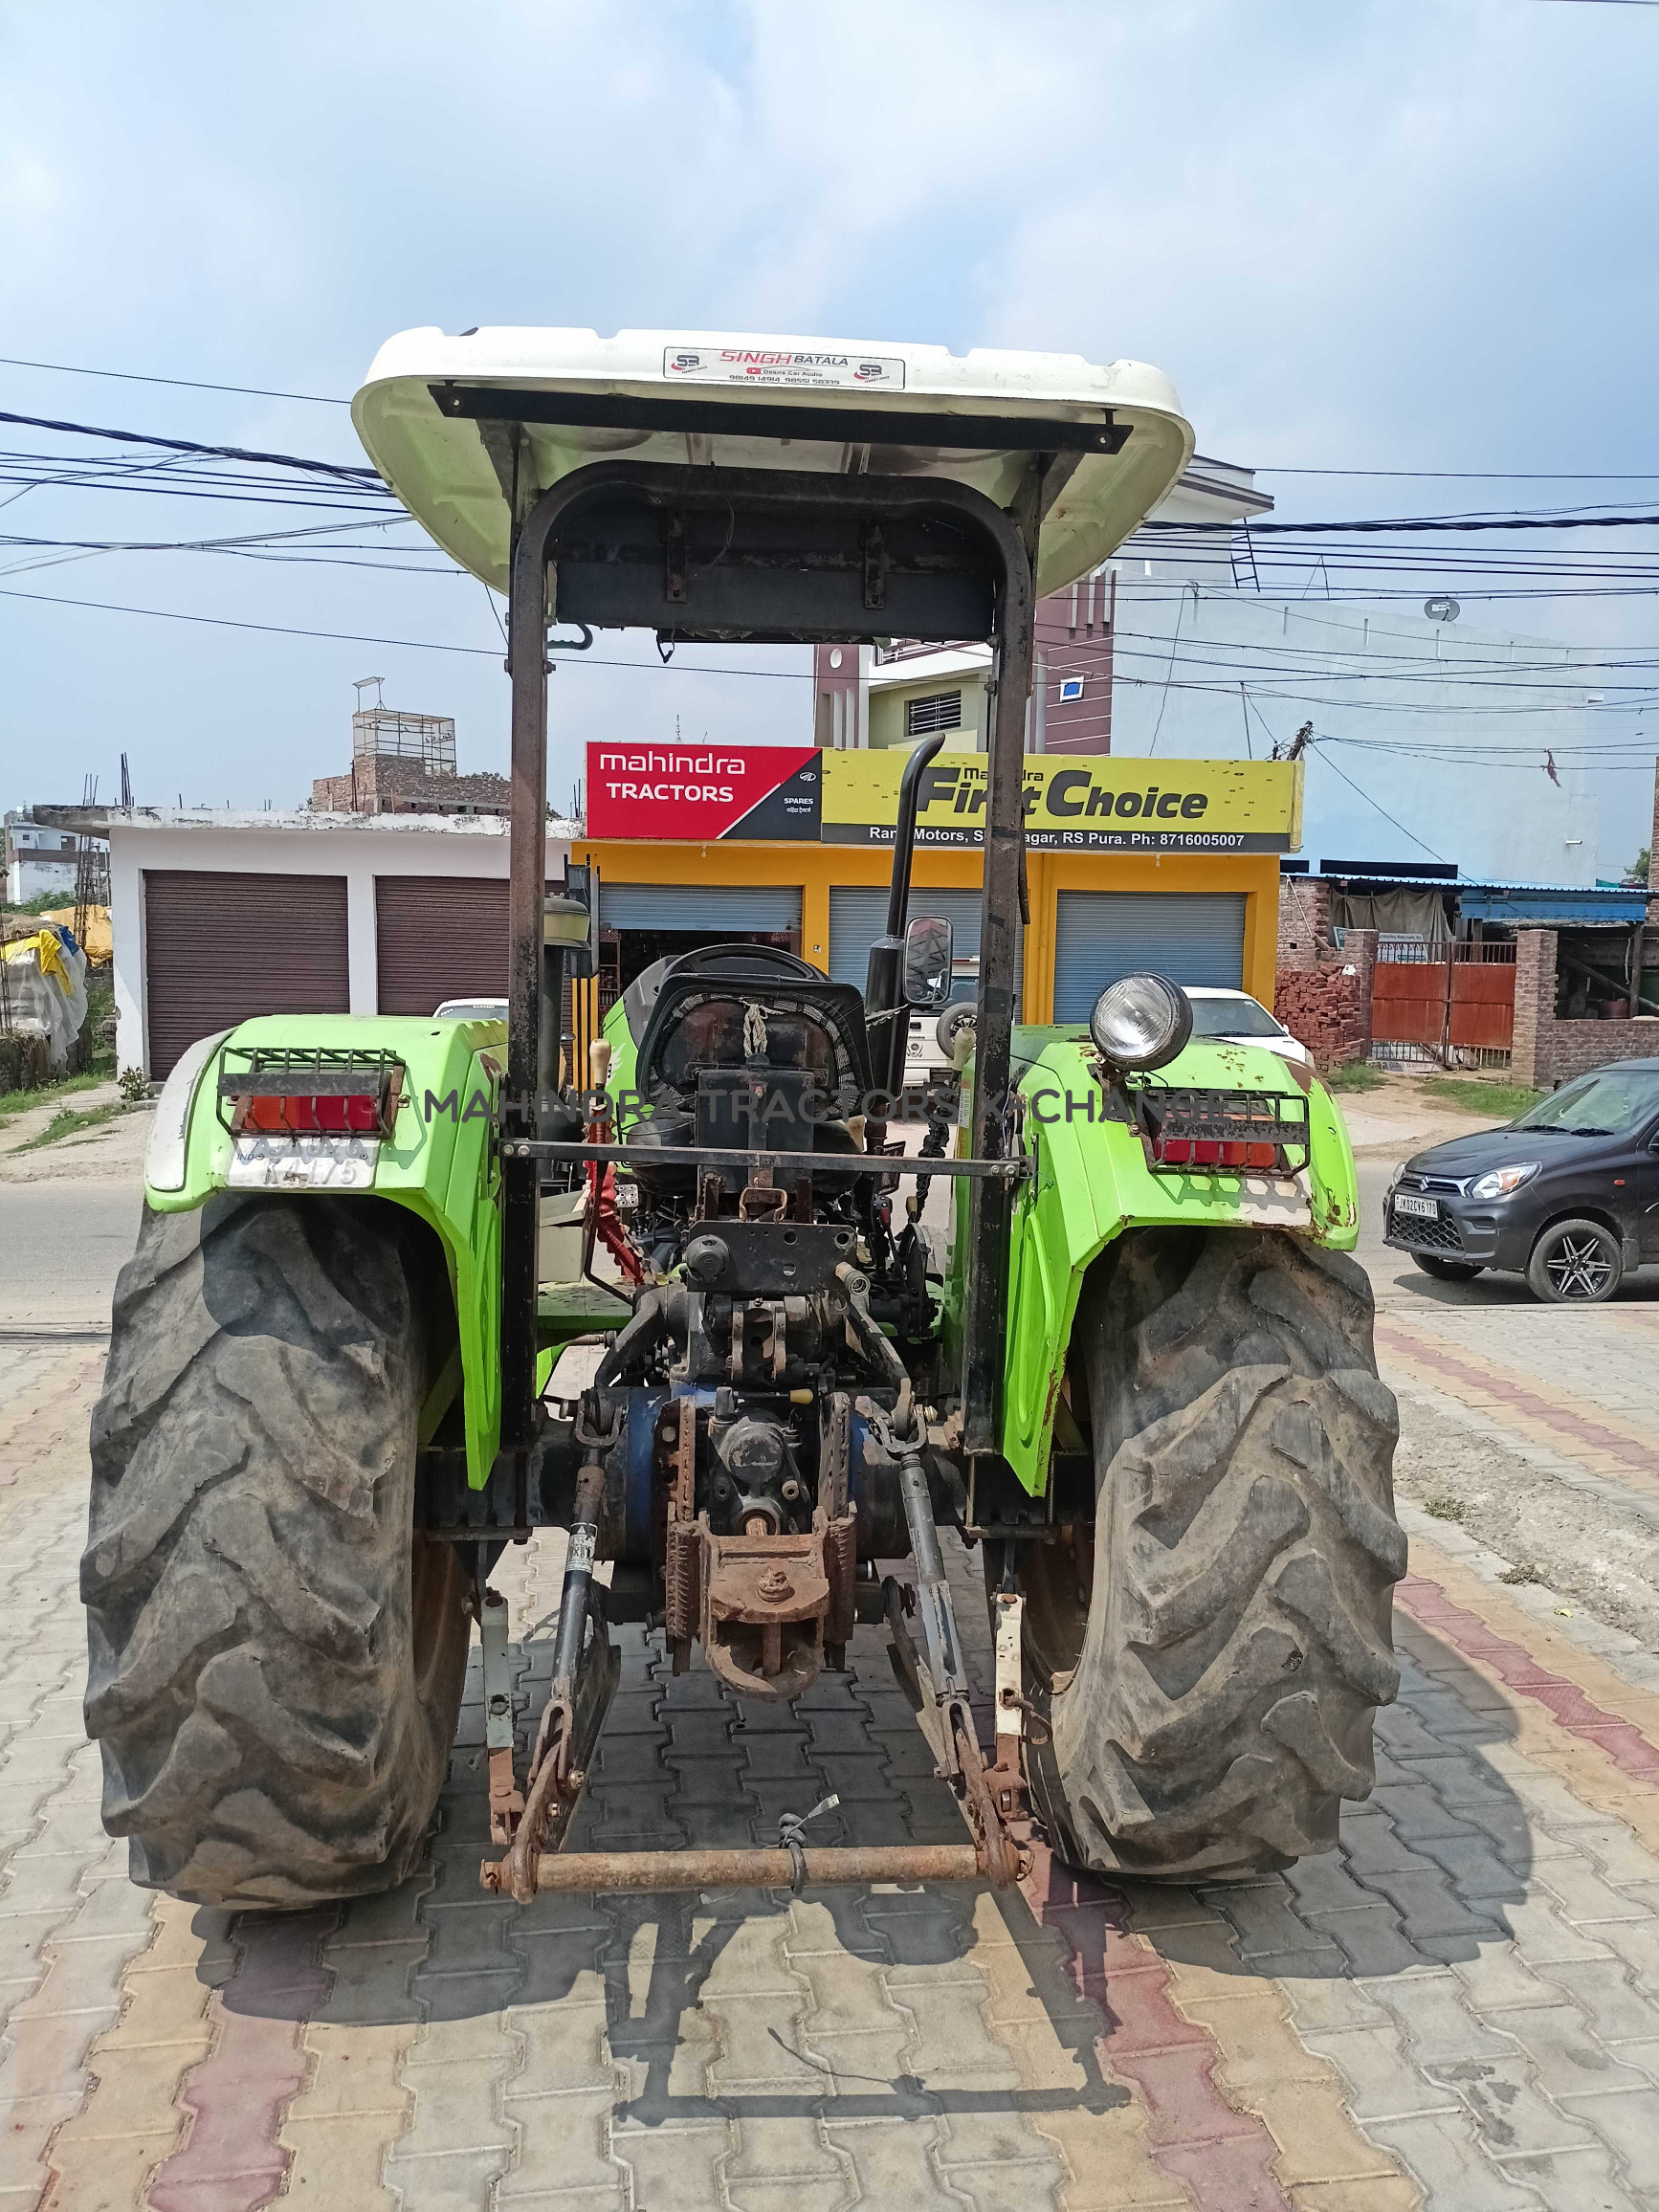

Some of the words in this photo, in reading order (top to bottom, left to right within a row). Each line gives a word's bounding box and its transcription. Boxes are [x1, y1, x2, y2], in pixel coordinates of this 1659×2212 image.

[719, 350, 792, 365] SINGH
[793, 355, 849, 365] BATALA
[600, 750, 745, 774] mahindra
[606, 782, 734, 803] TRACTORS
[917, 766, 1042, 816] Firt
[1046, 769, 1208, 819] Choice
[914, 828, 968, 843] Motors,
[1062, 831, 1084, 844] RS
[1088, 832, 1127, 845] Pura.
[1131, 833, 1156, 845] Ph:
[1160, 834, 1245, 847] 8716005007
